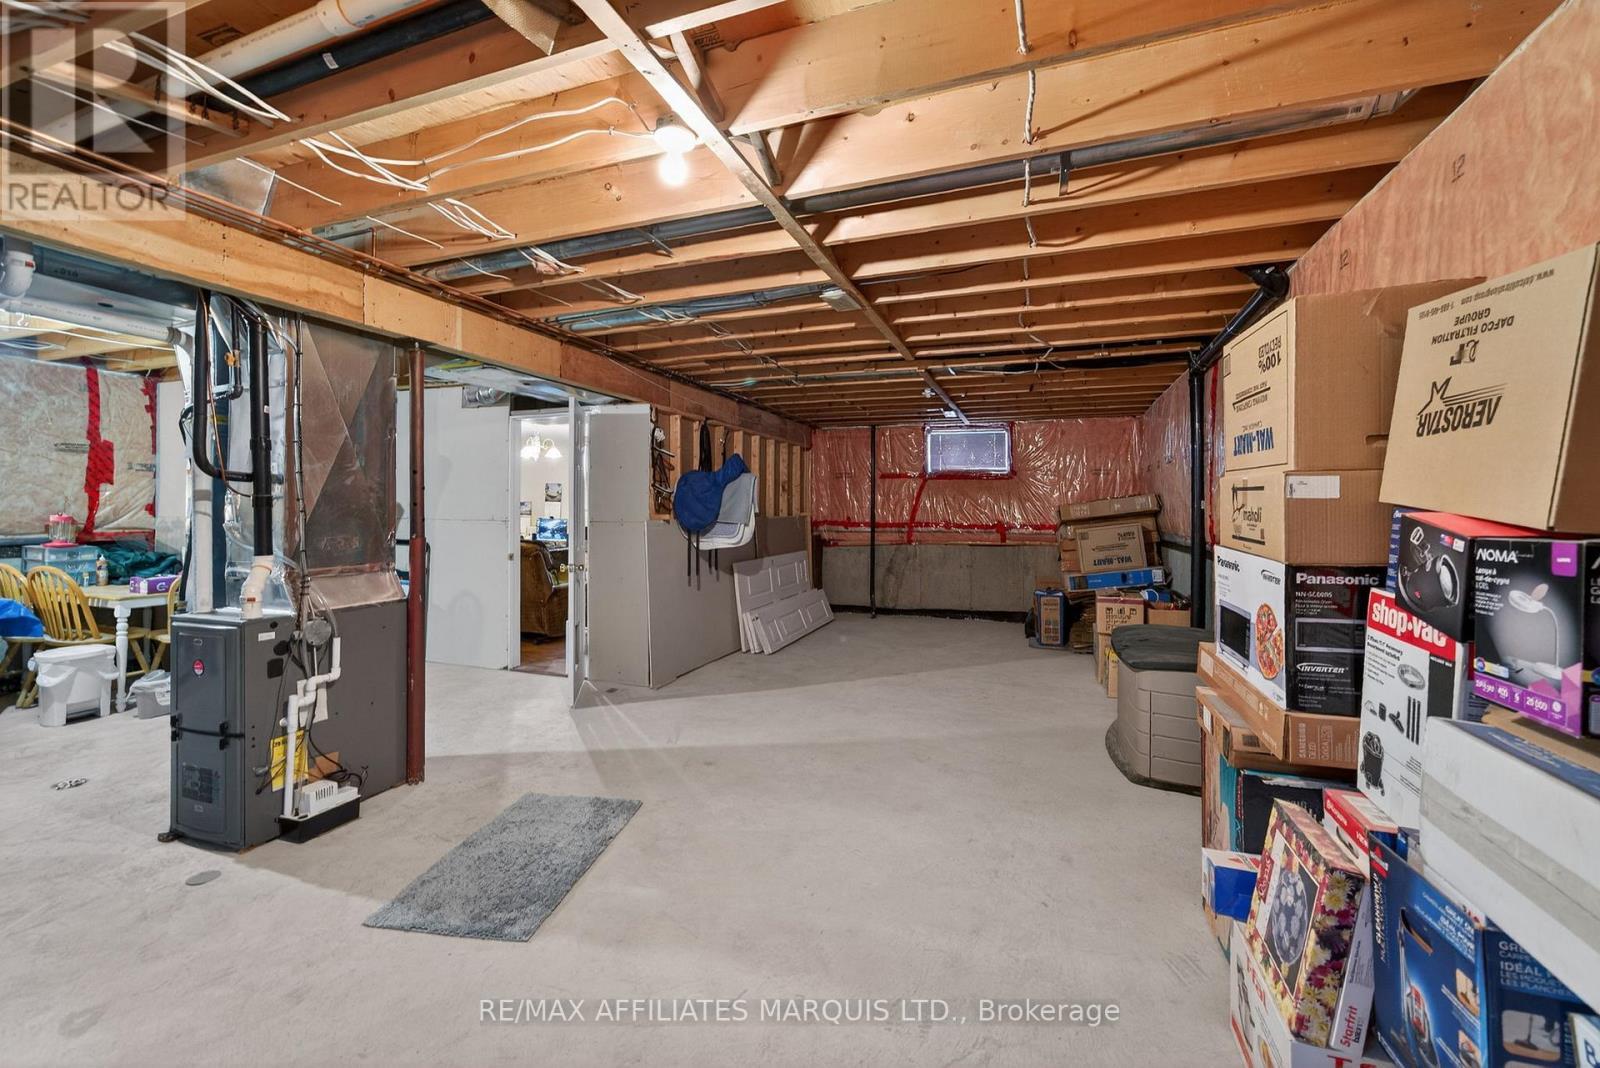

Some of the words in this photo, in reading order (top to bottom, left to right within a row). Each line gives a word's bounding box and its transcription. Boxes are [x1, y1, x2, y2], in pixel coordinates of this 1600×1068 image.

[1454, 307, 1491, 326] GROUPE
[1481, 315, 1515, 333] DAFCO
[1431, 324, 1480, 345] FILTRATION
[1258, 351, 1282, 375] 100%
[1416, 395, 1503, 438] AEROSTAR
[1476, 548, 1518, 563] NOMA
[1296, 572, 1379, 586] Panasonic
[1340, 1005, 1358, 1047] Starfrit
